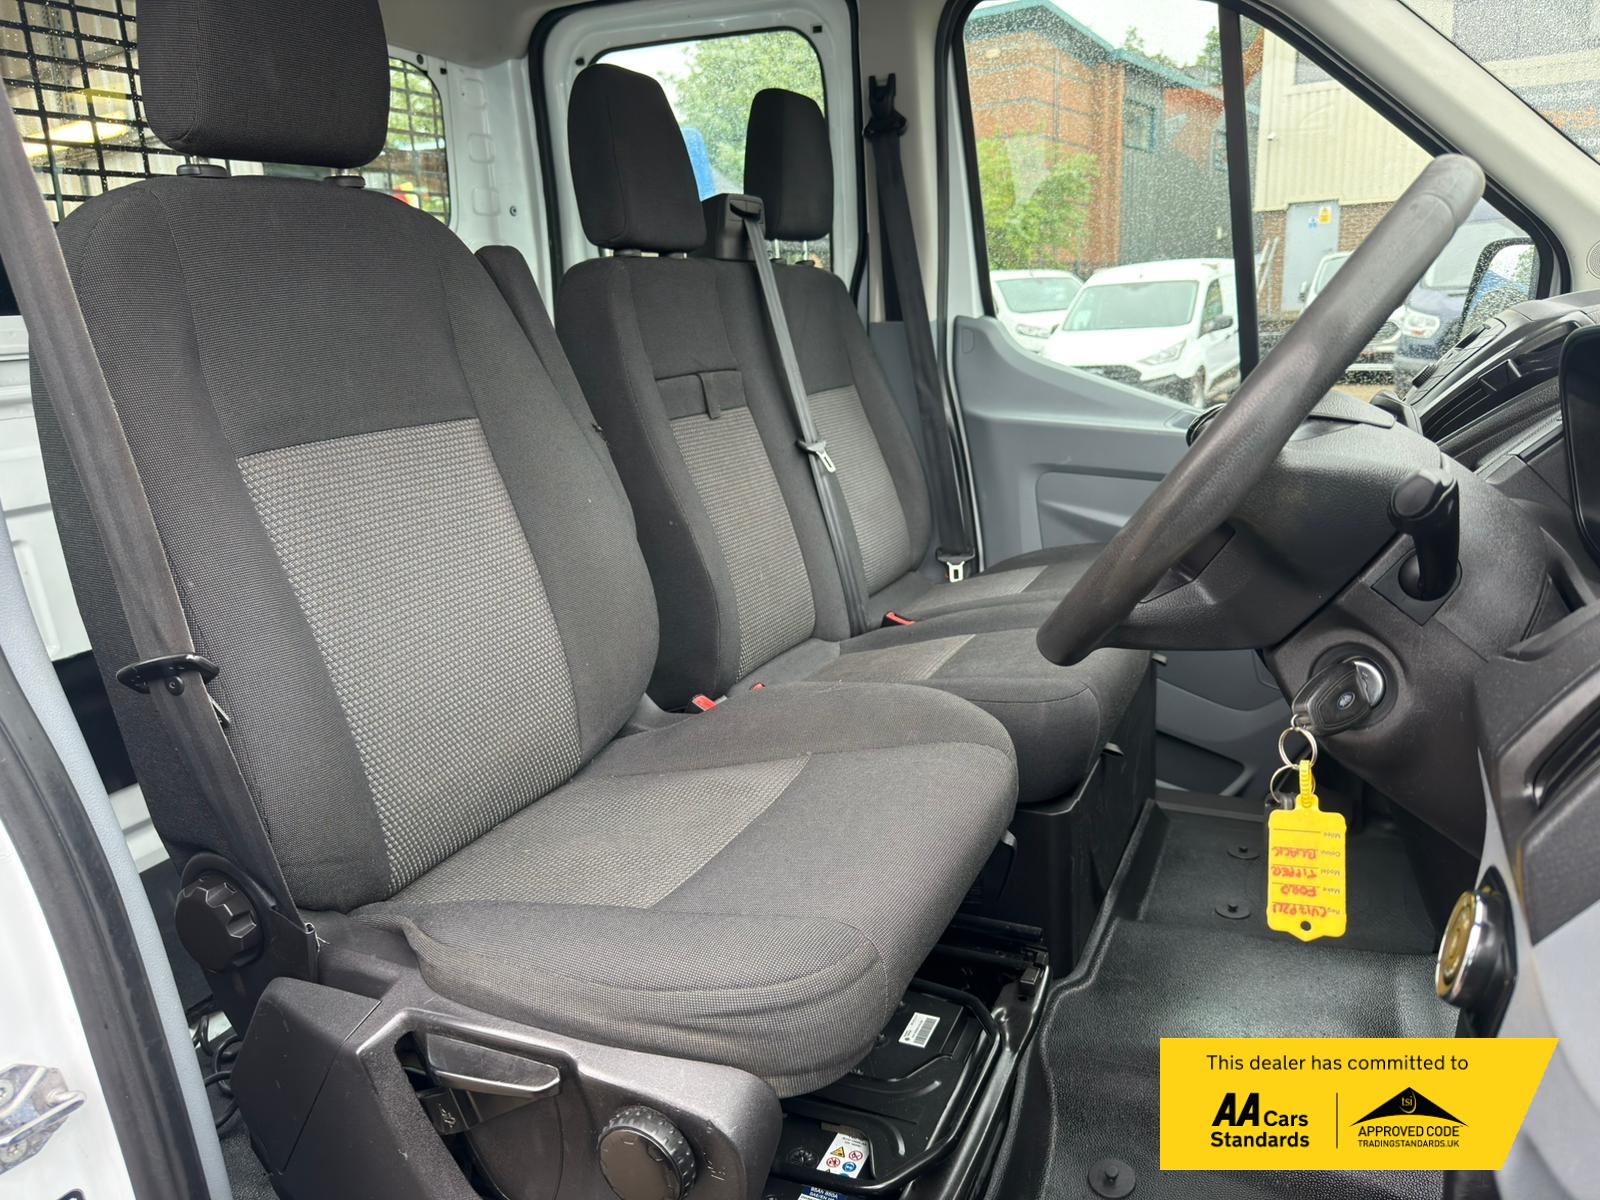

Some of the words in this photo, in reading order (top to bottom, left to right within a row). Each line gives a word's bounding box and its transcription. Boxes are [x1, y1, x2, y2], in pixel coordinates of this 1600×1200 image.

[1273, 847, 1318, 860] BLACK
[1271, 865, 1318, 879] TIPPER
[1280, 883, 1317, 897] FORD
